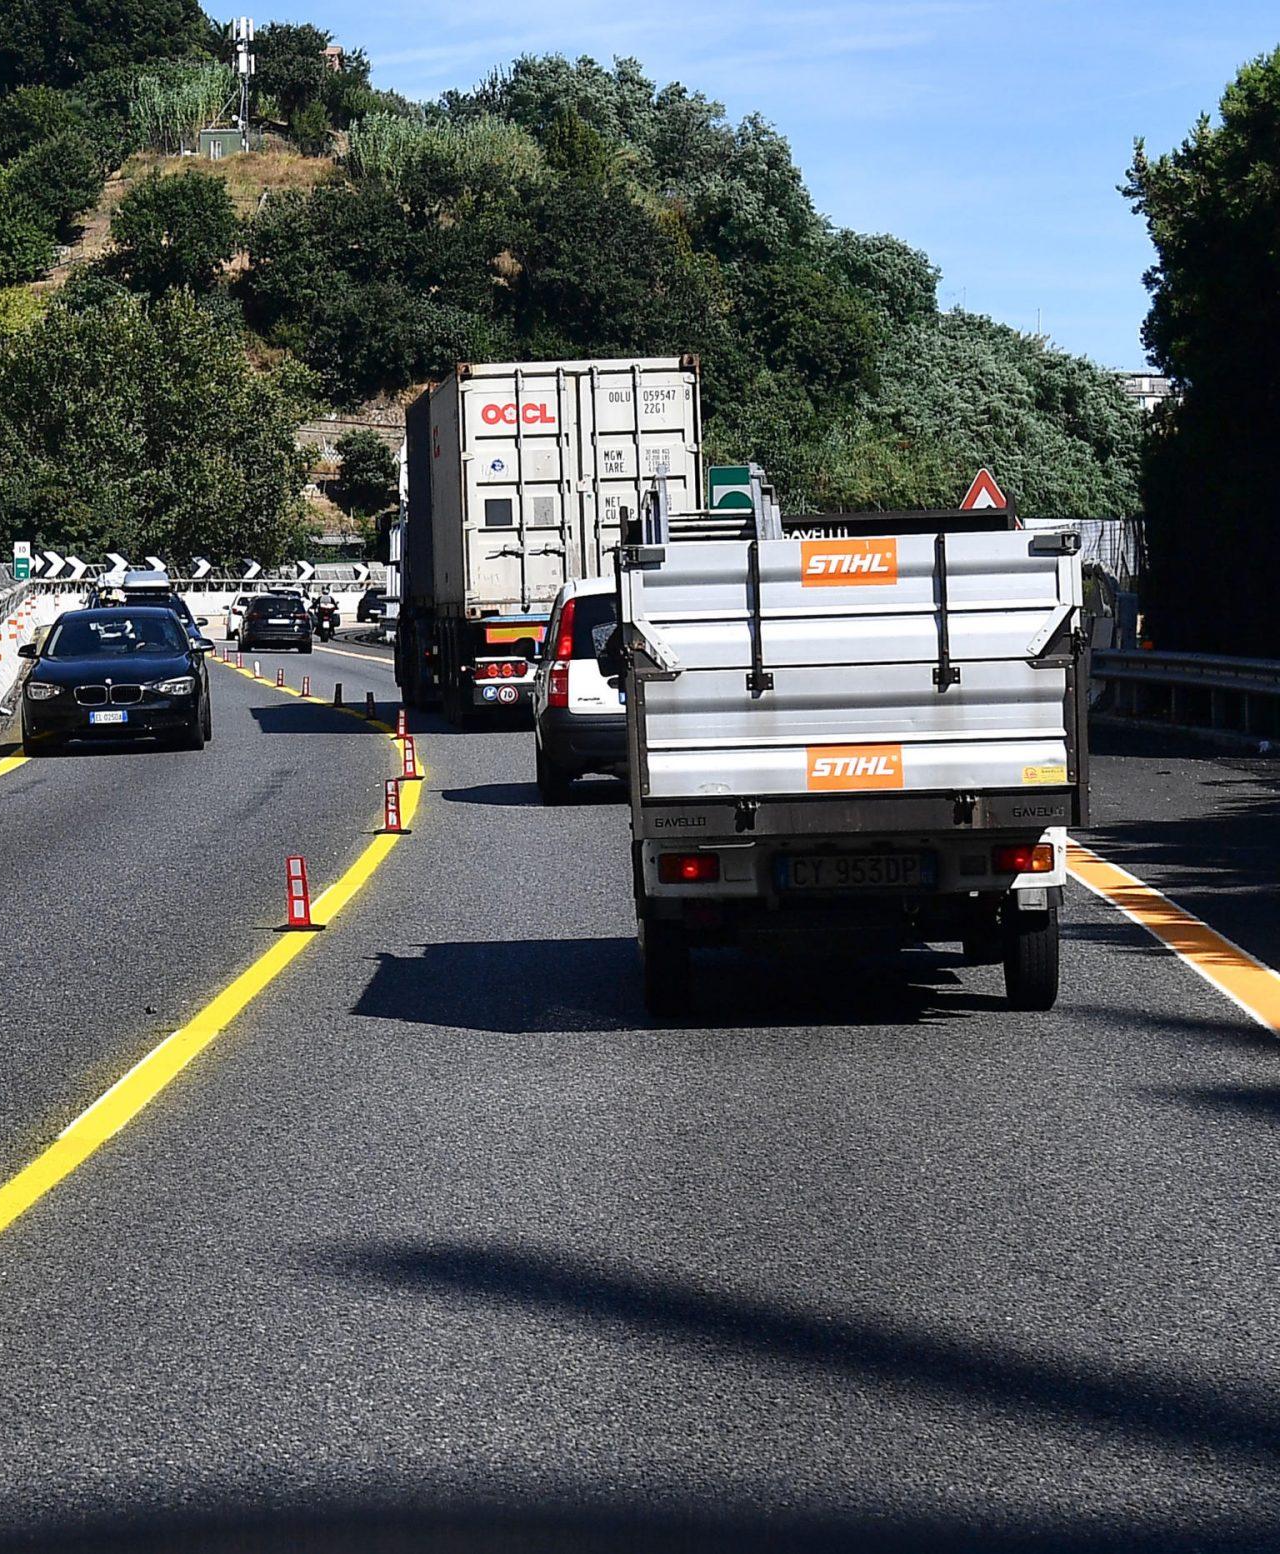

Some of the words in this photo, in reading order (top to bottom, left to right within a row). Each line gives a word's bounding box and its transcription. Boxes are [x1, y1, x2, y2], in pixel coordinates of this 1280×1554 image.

[643, 390, 676, 402] 059547
[481, 403, 556, 425] OOCL
[644, 403, 665, 414] 22G1
[805, 553, 890, 574] STIHL
[811, 756, 895, 777] STIHL
[654, 817, 706, 828] GAVELLO
